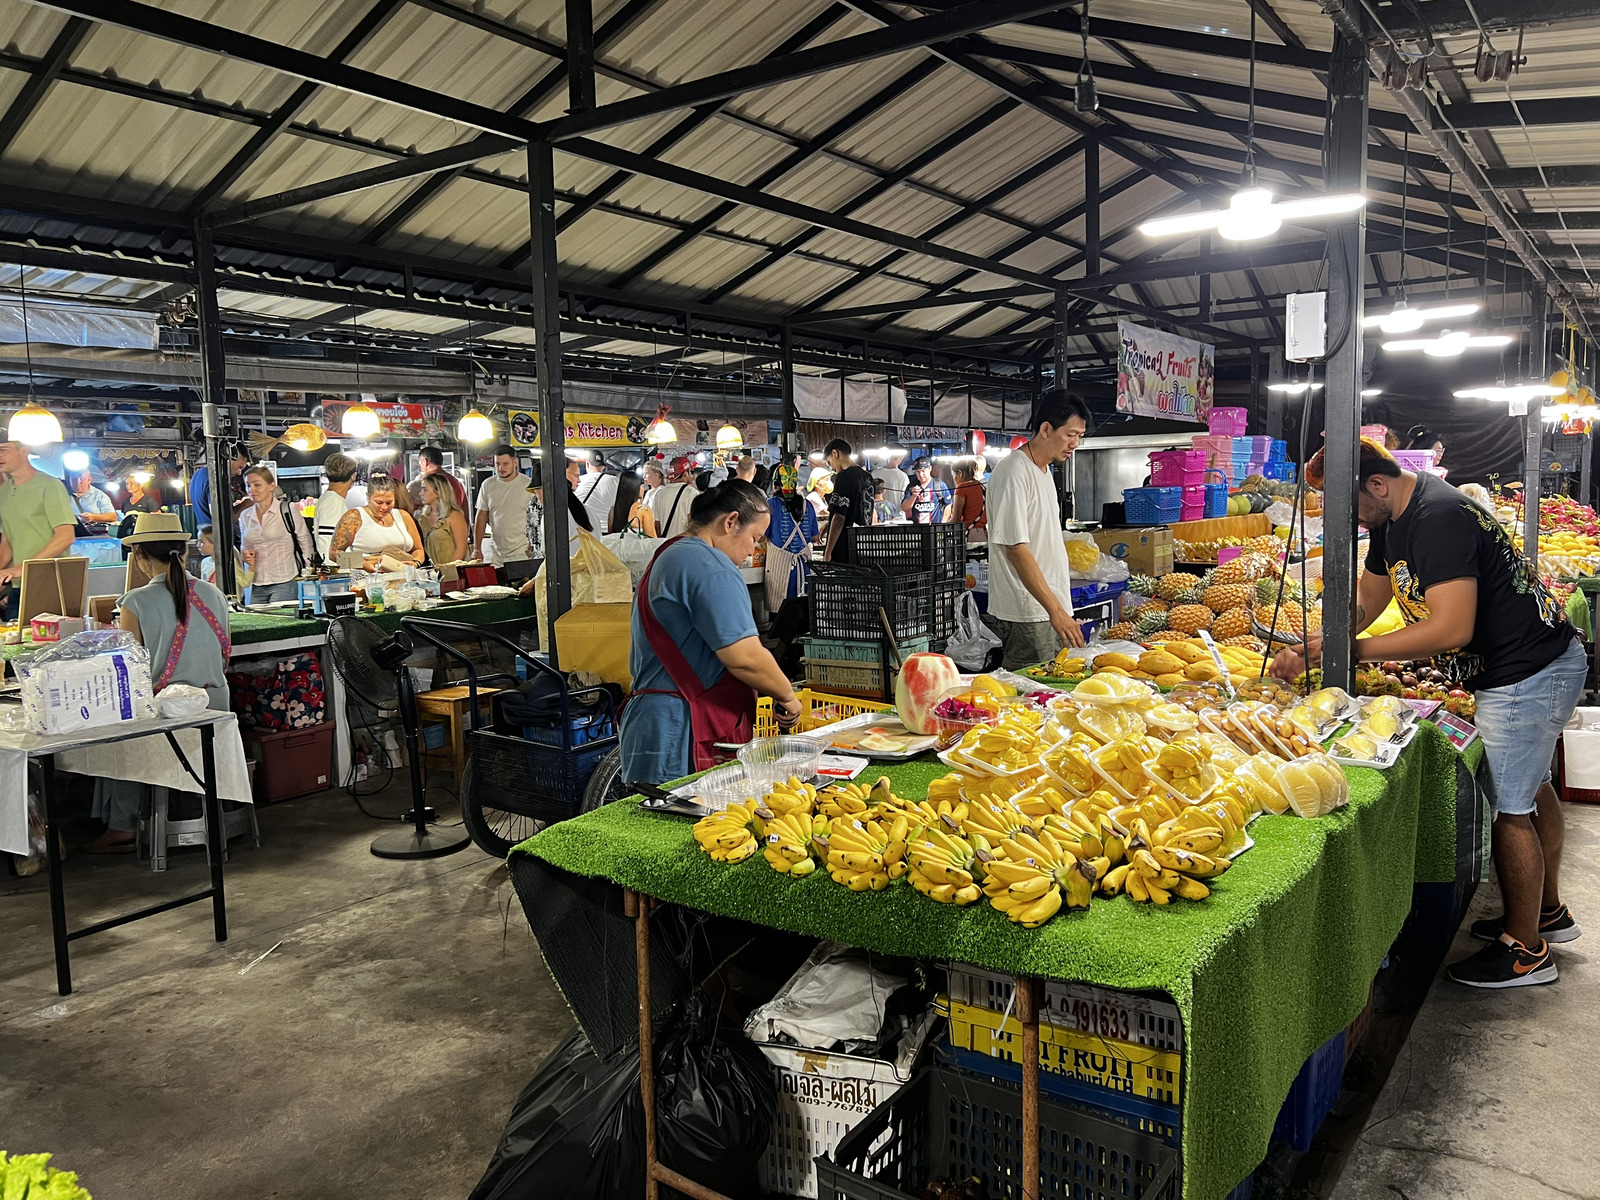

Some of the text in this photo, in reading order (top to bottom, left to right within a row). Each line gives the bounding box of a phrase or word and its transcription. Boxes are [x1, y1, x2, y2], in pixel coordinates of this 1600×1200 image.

[1122, 338, 1197, 381] Tropical Fruits
[576, 422, 623, 439] Kitchen
[898, 426, 912, 440] 789
[798, 1096, 871, 1114] 089-776782
